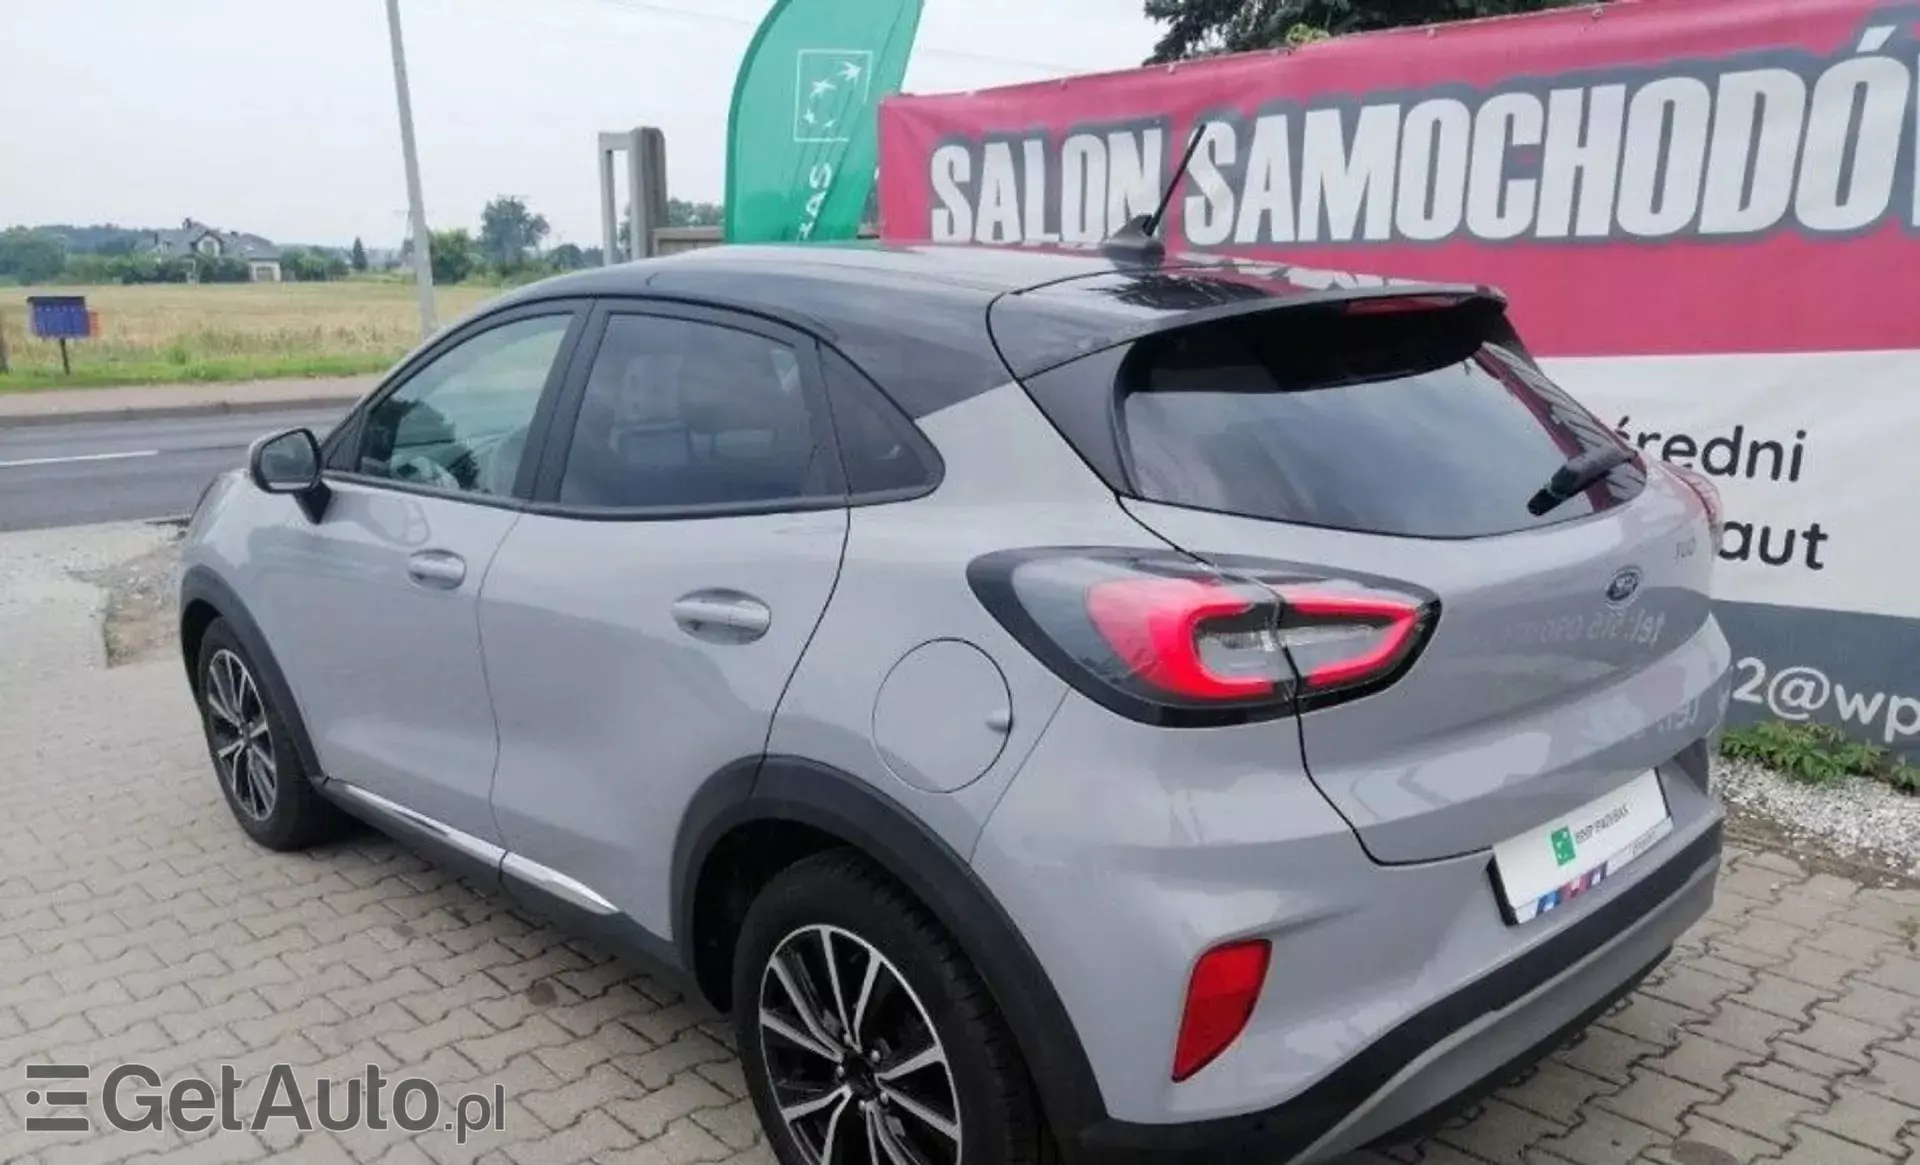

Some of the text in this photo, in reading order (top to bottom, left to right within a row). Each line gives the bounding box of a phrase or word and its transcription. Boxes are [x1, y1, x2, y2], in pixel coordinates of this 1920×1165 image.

[930, 25, 1920, 246] SALON SAMOCHODÓ
[1718, 520, 1829, 571] aut
